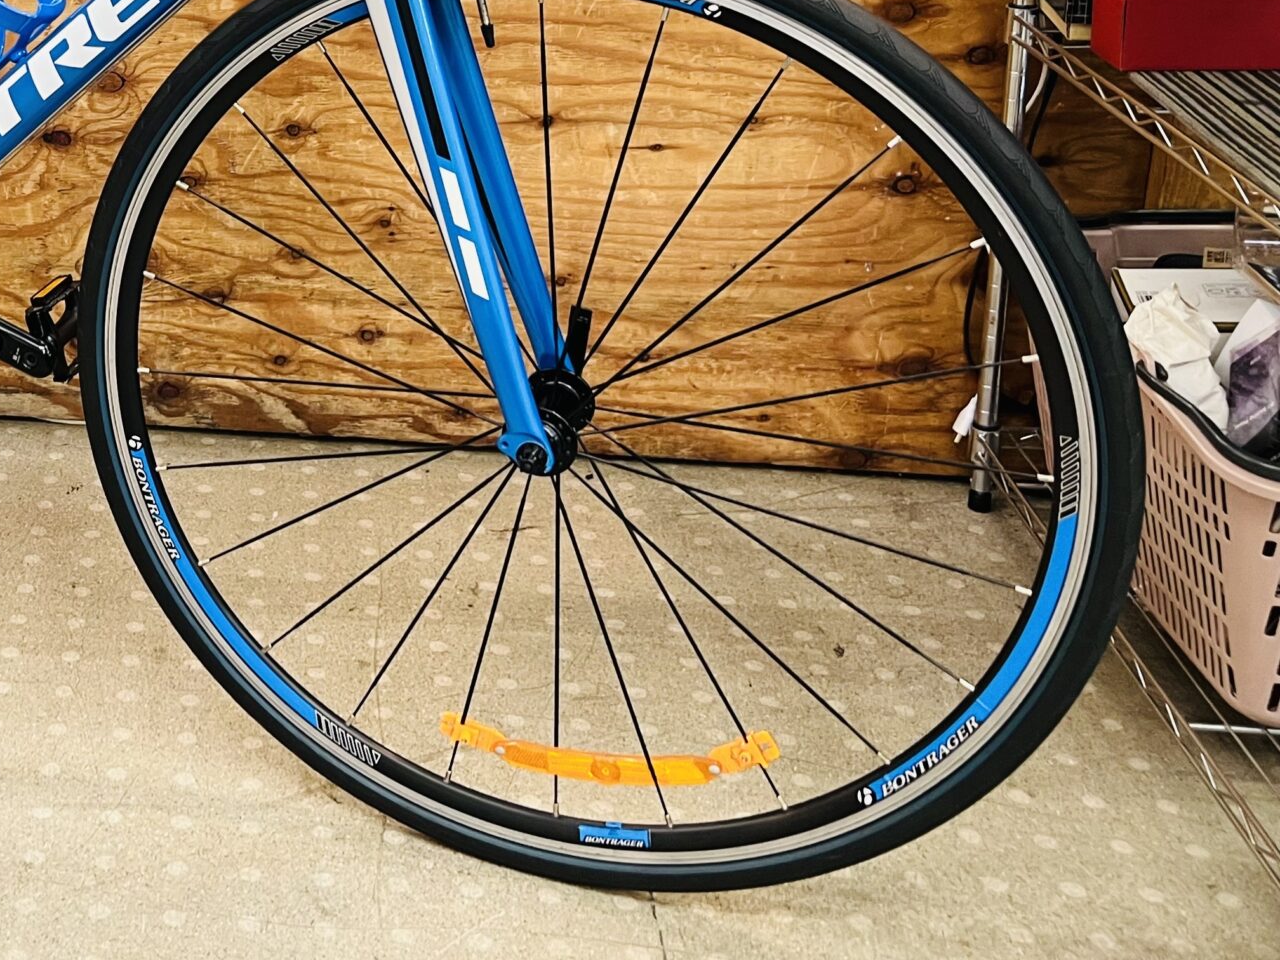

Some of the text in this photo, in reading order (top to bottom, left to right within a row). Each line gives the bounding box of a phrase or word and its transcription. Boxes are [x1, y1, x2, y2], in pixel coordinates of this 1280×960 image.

[131, 455, 182, 561] BONTRAGER
[880, 715, 980, 799] BONTRAGER
[584, 835, 644, 848] BONTRAGER
